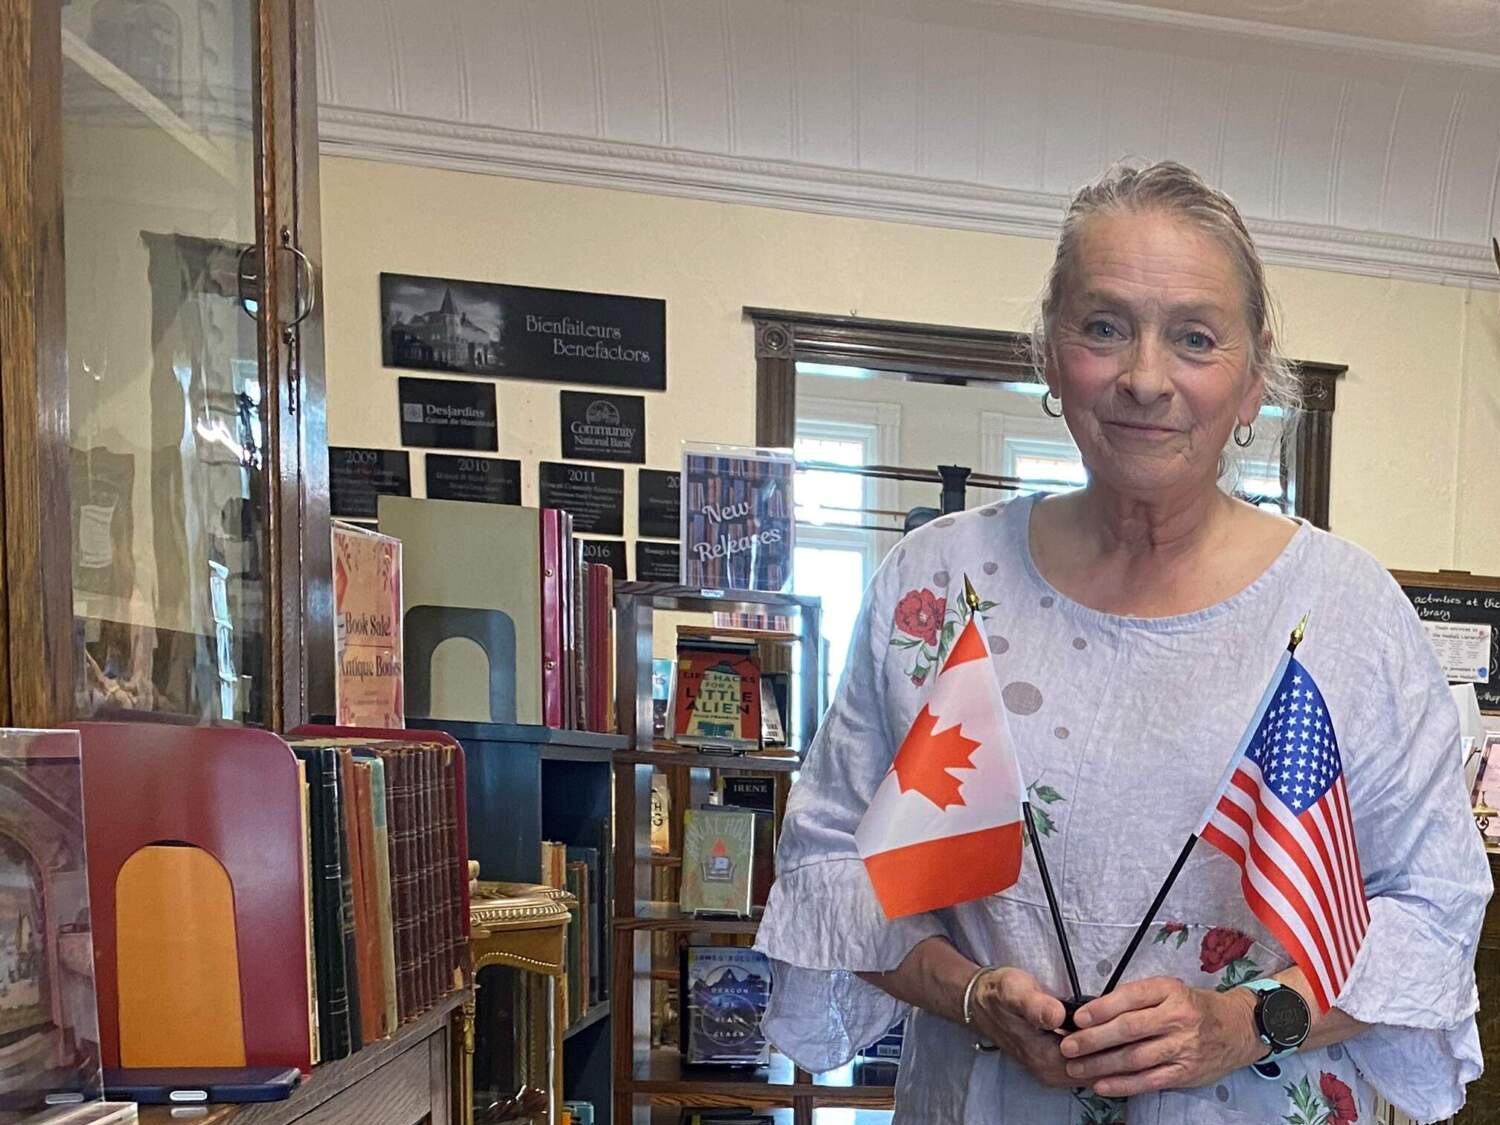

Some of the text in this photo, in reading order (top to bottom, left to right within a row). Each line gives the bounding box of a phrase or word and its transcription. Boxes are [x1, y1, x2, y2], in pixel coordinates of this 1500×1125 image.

[525, 314, 621, 339] Bienfaiteurs
[553, 338, 650, 362] Benefactors
[426, 404, 485, 418] Desjardins
[571, 421, 636, 439] Community
[346, 451, 378, 465] 2009
[458, 458, 490, 473] 2010
[567, 469, 597, 483] 2011
[702, 502, 752, 525] New
[583, 544, 611, 558] 2016
[693, 528, 782, 562] Releases
[1466, 598, 1479, 606] at
[345, 611, 369, 635] Book
[713, 674, 756, 683] HACKS
[686, 688, 753, 703] LITTLE
[685, 700, 750, 715] ALIEN
[733, 784, 768, 793] IRENE
